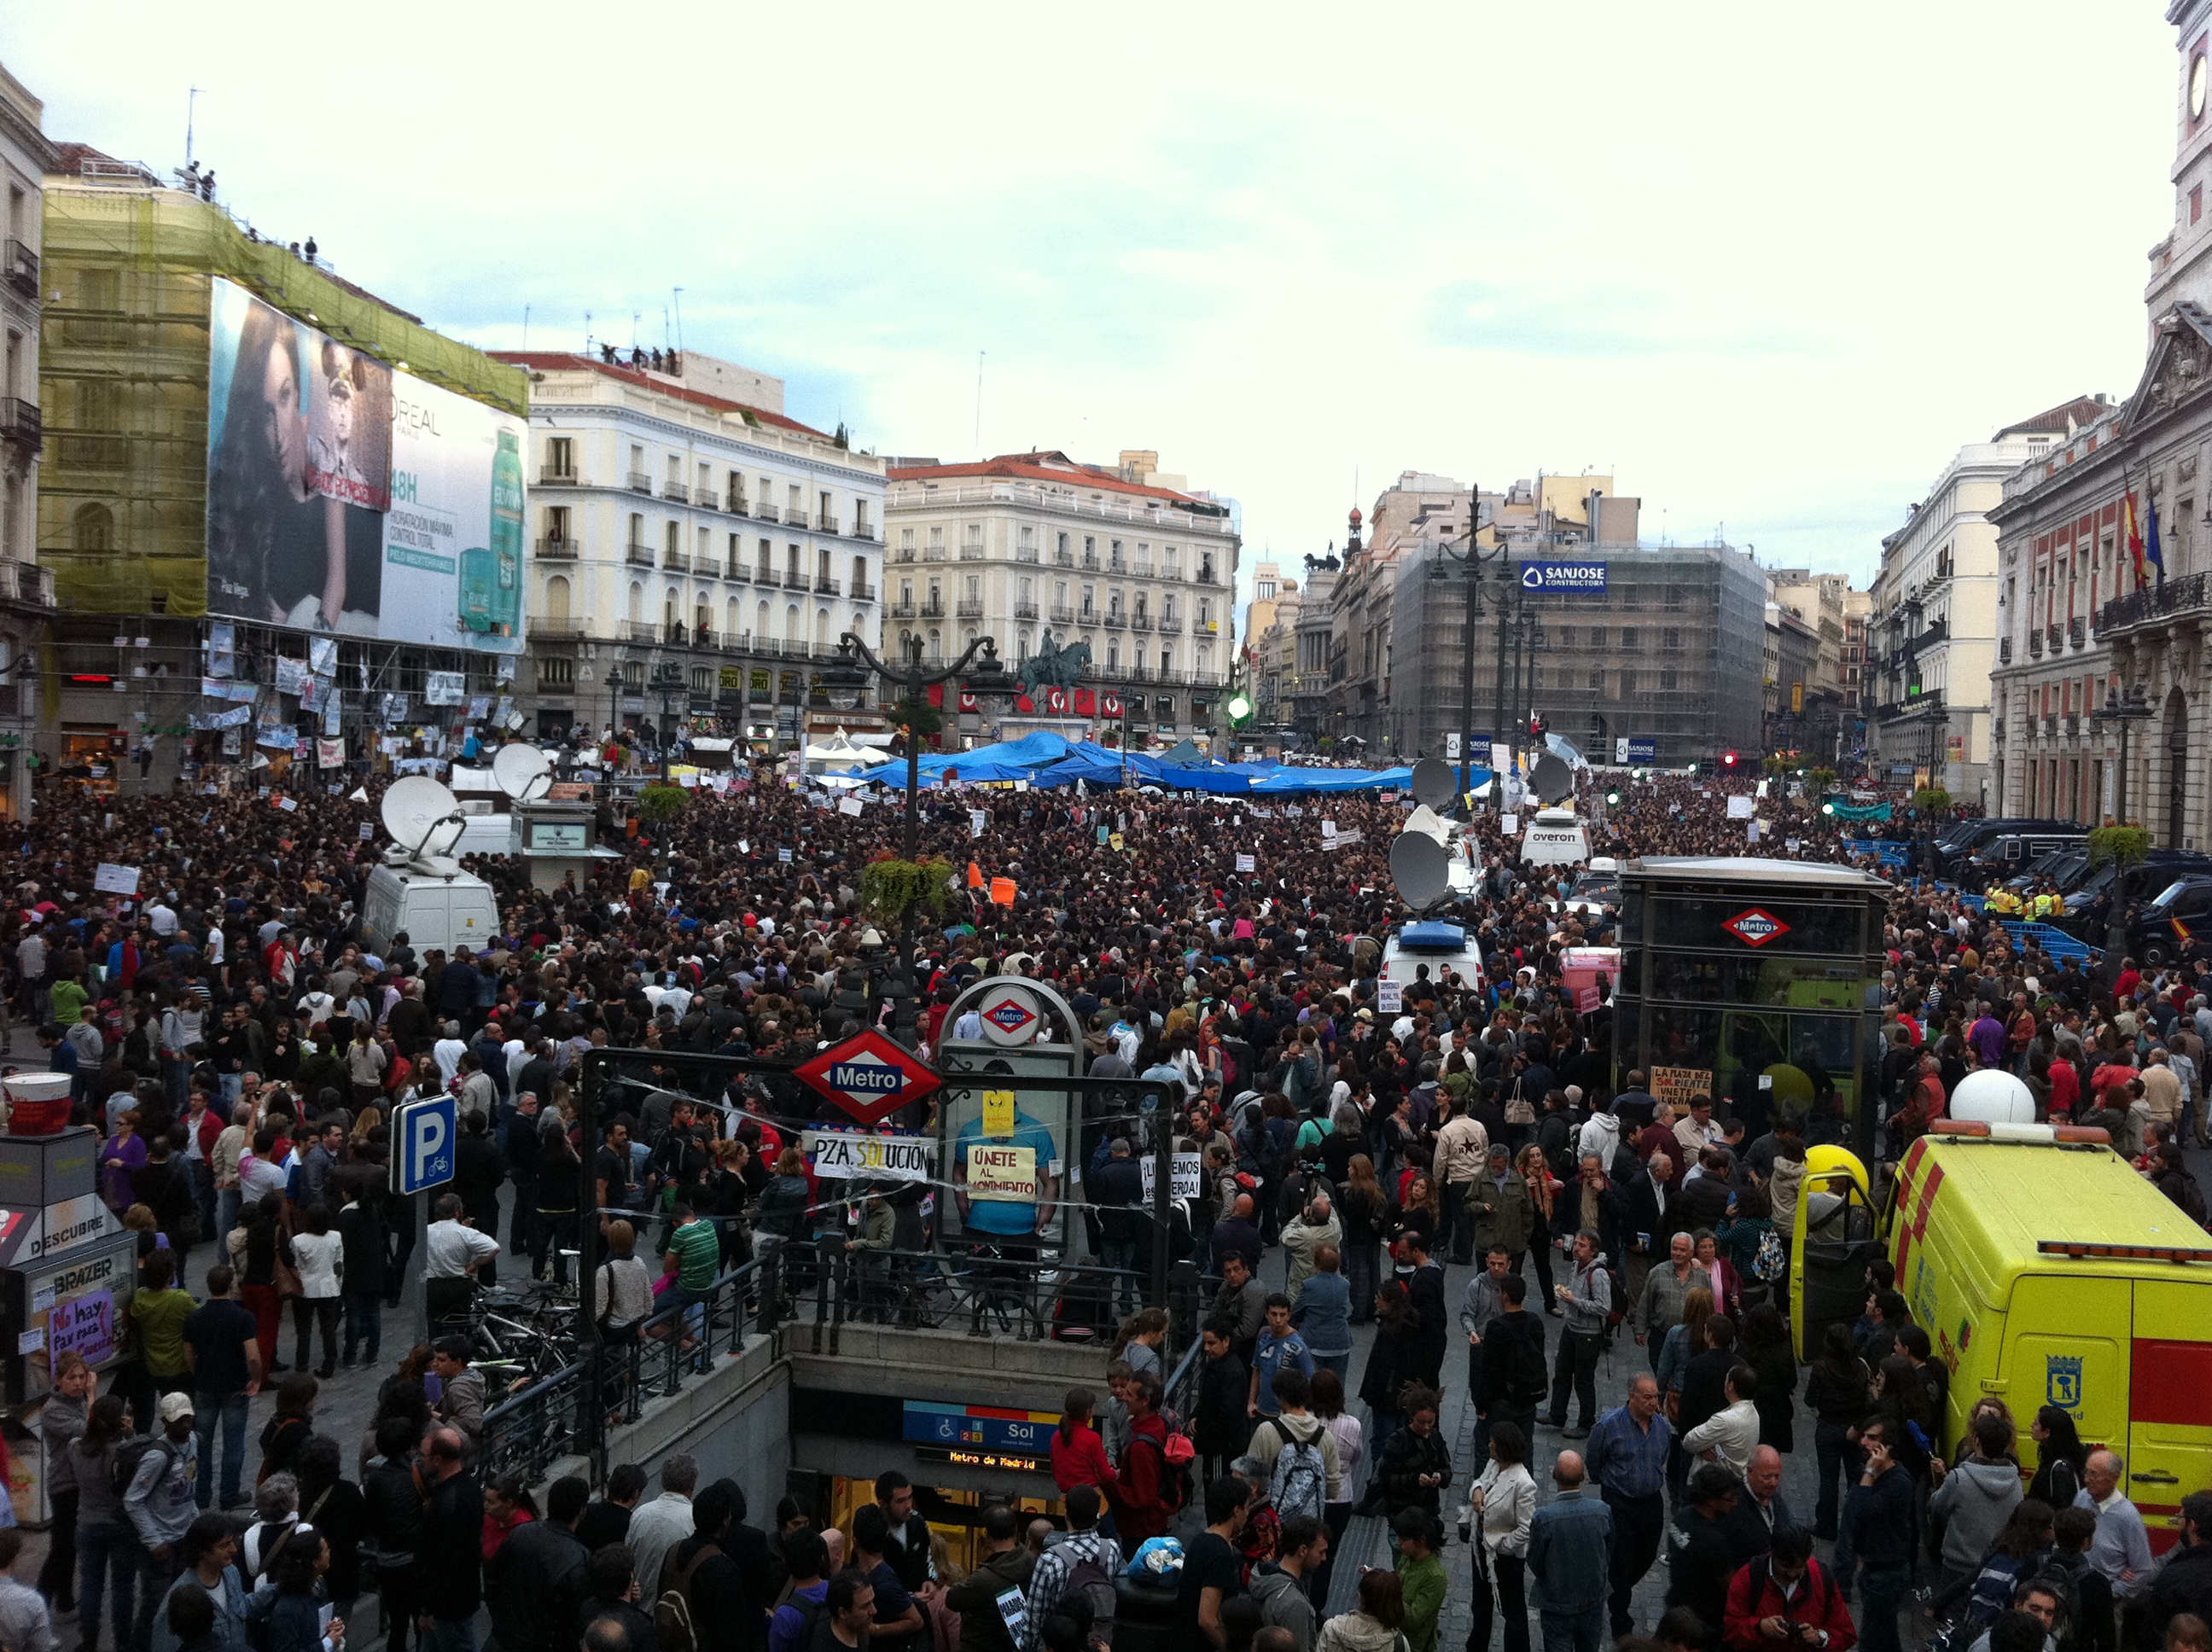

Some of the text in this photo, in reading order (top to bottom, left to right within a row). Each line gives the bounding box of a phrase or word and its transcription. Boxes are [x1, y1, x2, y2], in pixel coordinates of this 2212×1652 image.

[1545, 567, 1604, 579] SANJOSE
[1533, 833, 1576, 842] overon
[1739, 921, 1773, 932] Metro
[995, 1010, 1023, 1023] Metro
[836, 1066, 897, 1089] Metro
[1655, 1068, 1668, 1078] LA
[1695, 1072, 1711, 1080] DEL
[415, 1112, 445, 1182] P
[816, 1139, 854, 1166] PZA.
[975, 1147, 1017, 1167] ÚNETE
[980, 1167, 994, 1178] AL
[969, 1179, 1035, 1195] MOVIMIENTO
[31, 1215, 104, 1256] DESCUBRE
[55, 1258, 112, 1296] BRAZER
[1008, 1423, 1033, 1440] Sol
[950, 1451, 1036, 1470] Metro de Madrid
